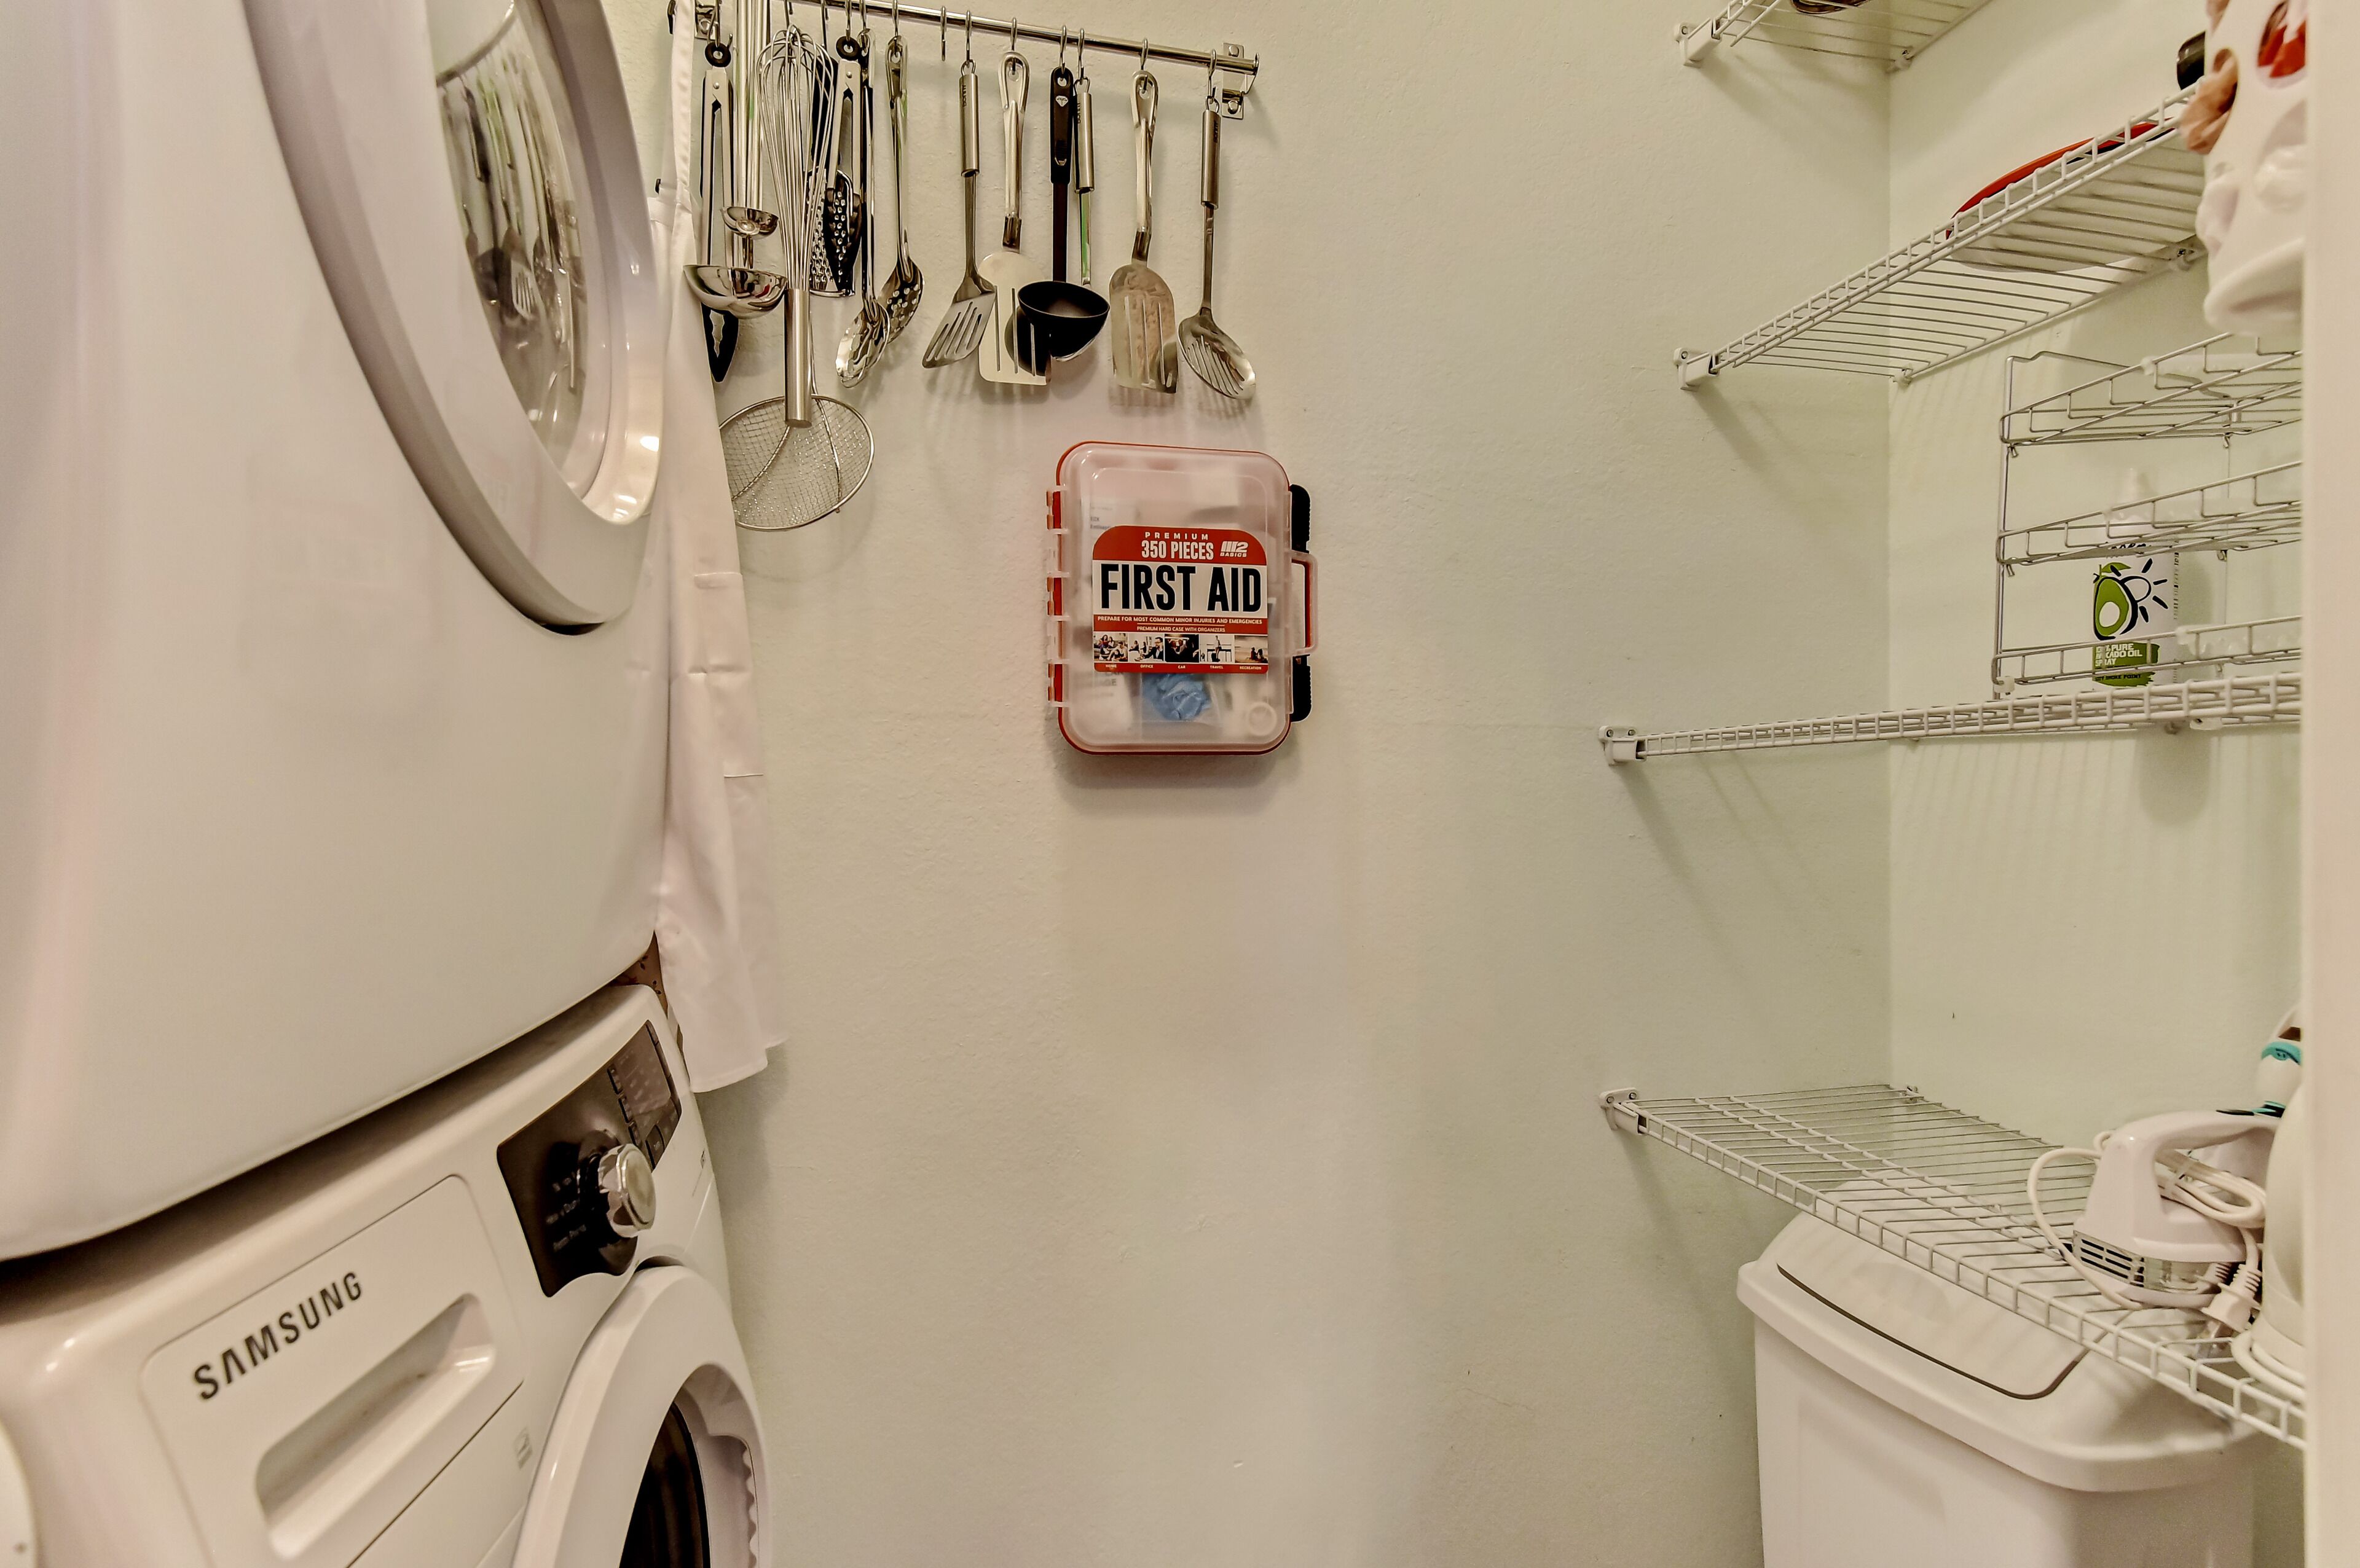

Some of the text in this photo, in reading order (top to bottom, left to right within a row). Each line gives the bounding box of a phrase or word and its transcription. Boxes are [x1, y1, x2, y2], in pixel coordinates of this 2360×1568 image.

[1141, 540, 1214, 560] 350 PIECES
[1145, 531, 1208, 540] PREMIUM
[1101, 563, 1261, 612] FIRST AID
[193, 1271, 363, 1401] SAMSUNG
